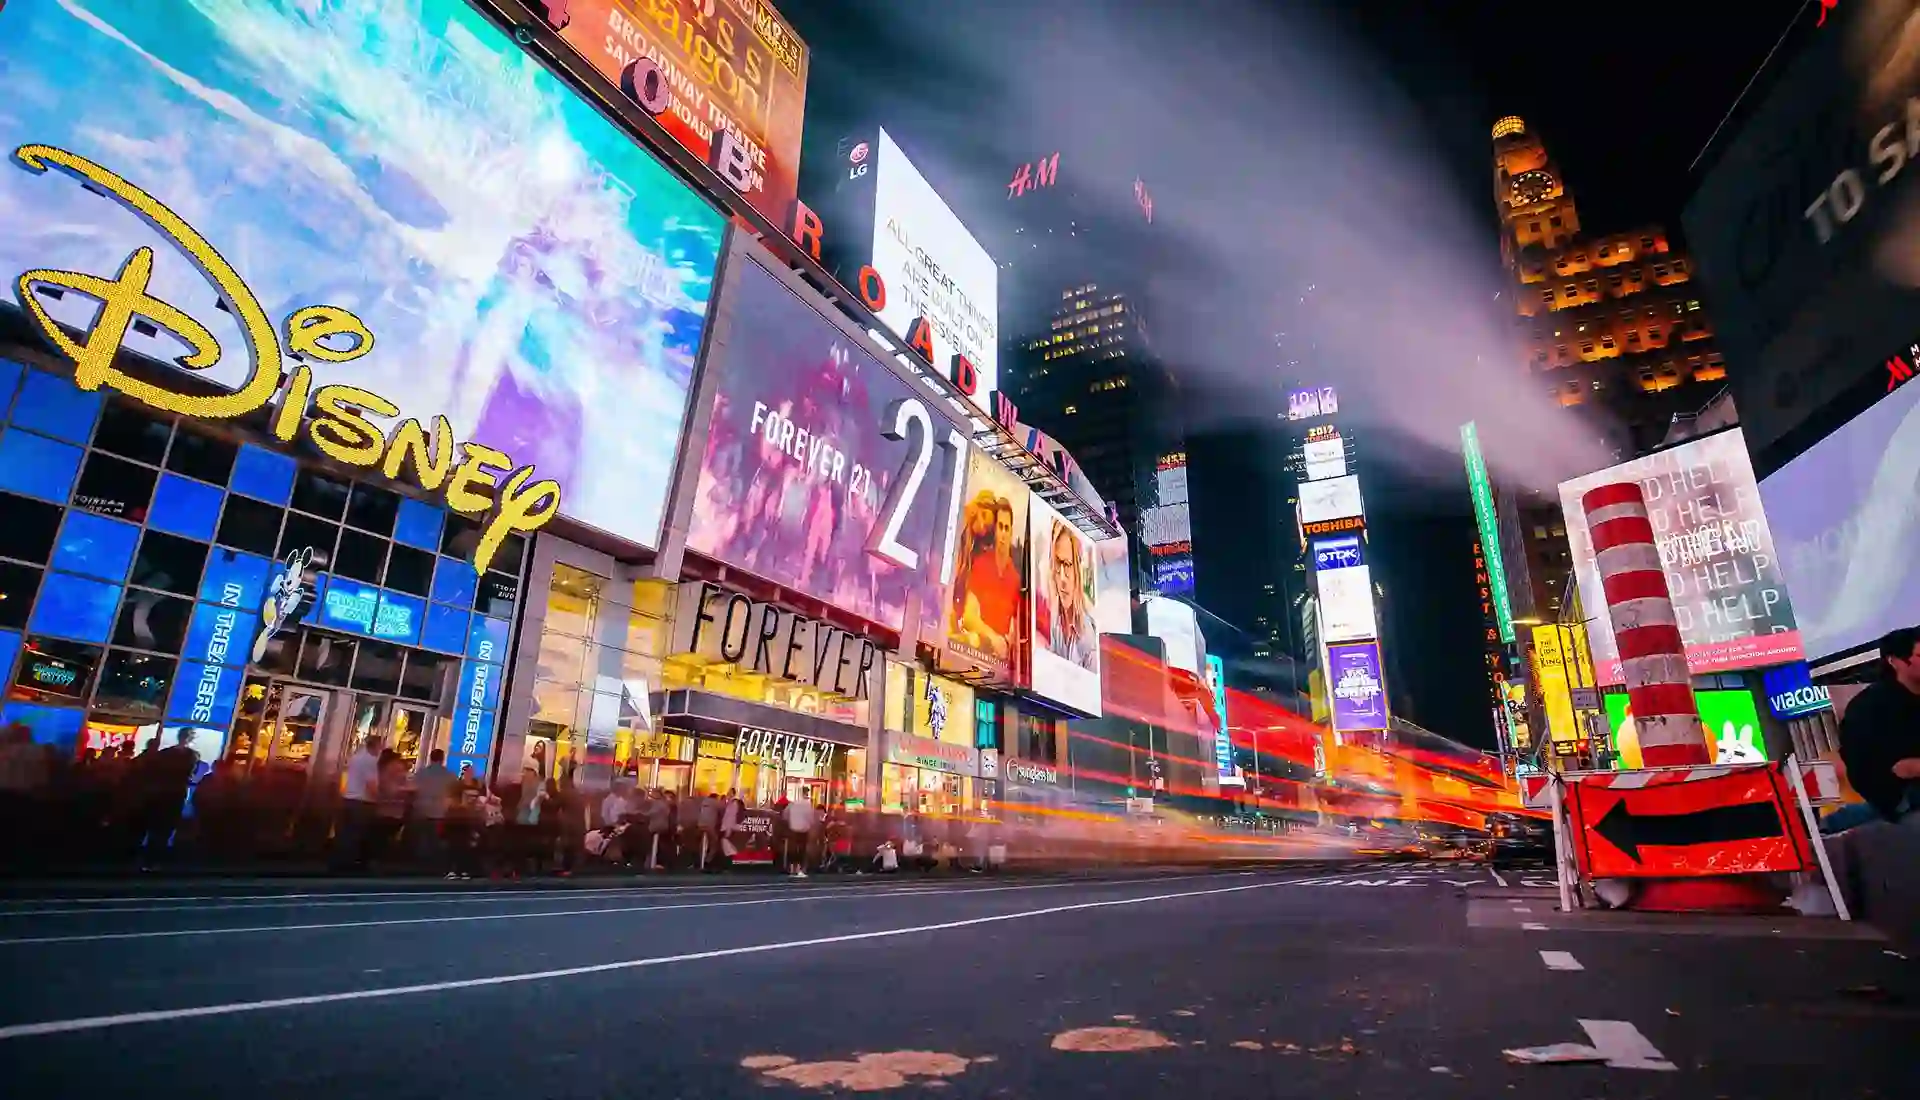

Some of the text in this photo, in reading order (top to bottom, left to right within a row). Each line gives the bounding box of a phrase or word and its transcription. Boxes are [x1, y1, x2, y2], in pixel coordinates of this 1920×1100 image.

[608, 8, 704, 109] BROADWAY
[645, 0, 759, 118] aigon
[849, 163, 868, 180] LG
[1804, 168, 1865, 244] TO
[886, 216, 996, 340] ALL GREAT THINGS
[902, 260, 984, 351] ARE BUILT ON
[901, 284, 985, 375] THE ESSENCE
[750, 400, 872, 496] FOREVER 21
[870, 398, 968, 585] 21
[1303, 517, 1365, 535] TOSHIBA
[1676, 486, 1748, 527] HELP
[1327, 549, 1358, 562] TDK
[1473, 543, 1489, 615] ERNST
[1694, 554, 1771, 593] HELP
[690, 582, 875, 700] FOREVER
[1701, 588, 1781, 630] HELP
[191, 582, 244, 724] IN THEATERS
[479, 640, 492, 661] IN
[1540, 658, 1562, 669] KING
[461, 663, 489, 755] THEATERS
[735, 727, 836, 768] FOREVER 21
[916, 756, 937, 768] SINCE
